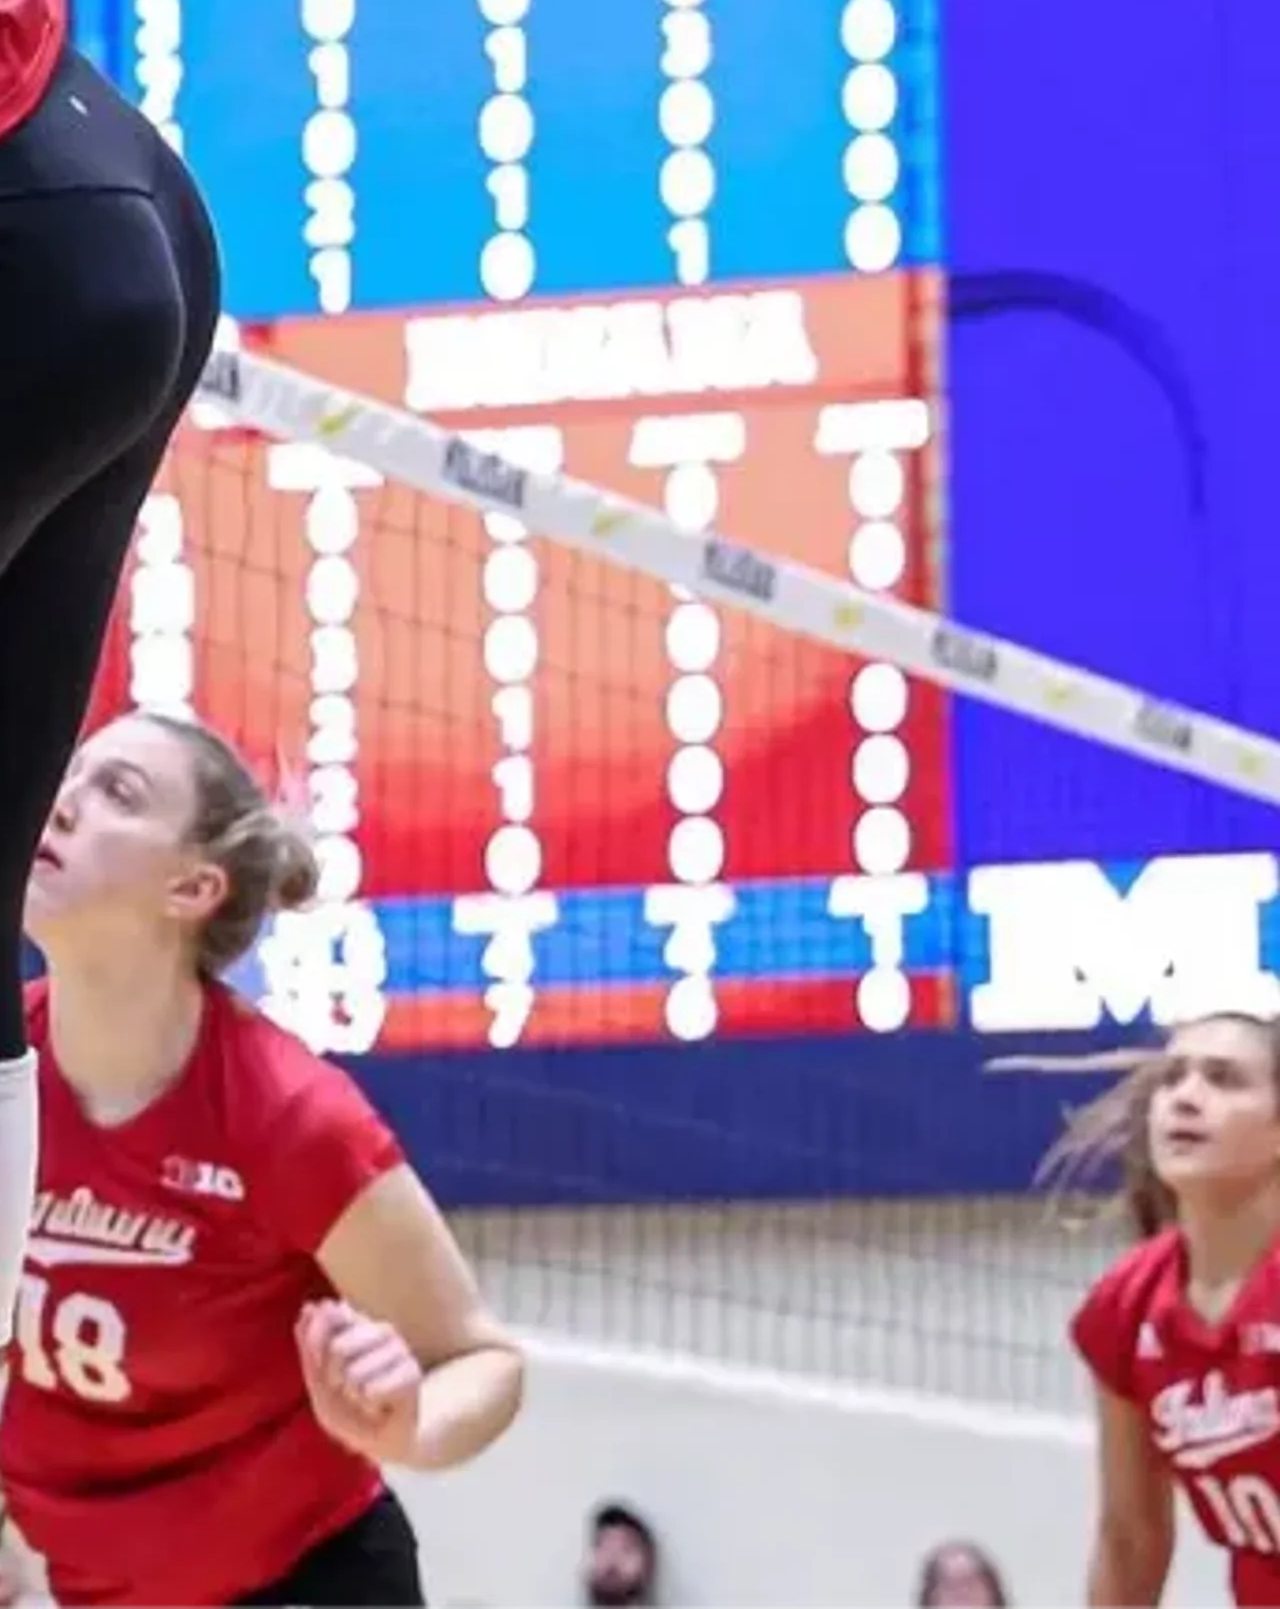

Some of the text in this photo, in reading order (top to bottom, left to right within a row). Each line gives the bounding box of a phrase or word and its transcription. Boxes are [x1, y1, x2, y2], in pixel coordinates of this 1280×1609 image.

[968, 853, 1280, 1032] M
[17, 1272, 132, 1402] 18
[1193, 1473, 1280, 1553] 10
